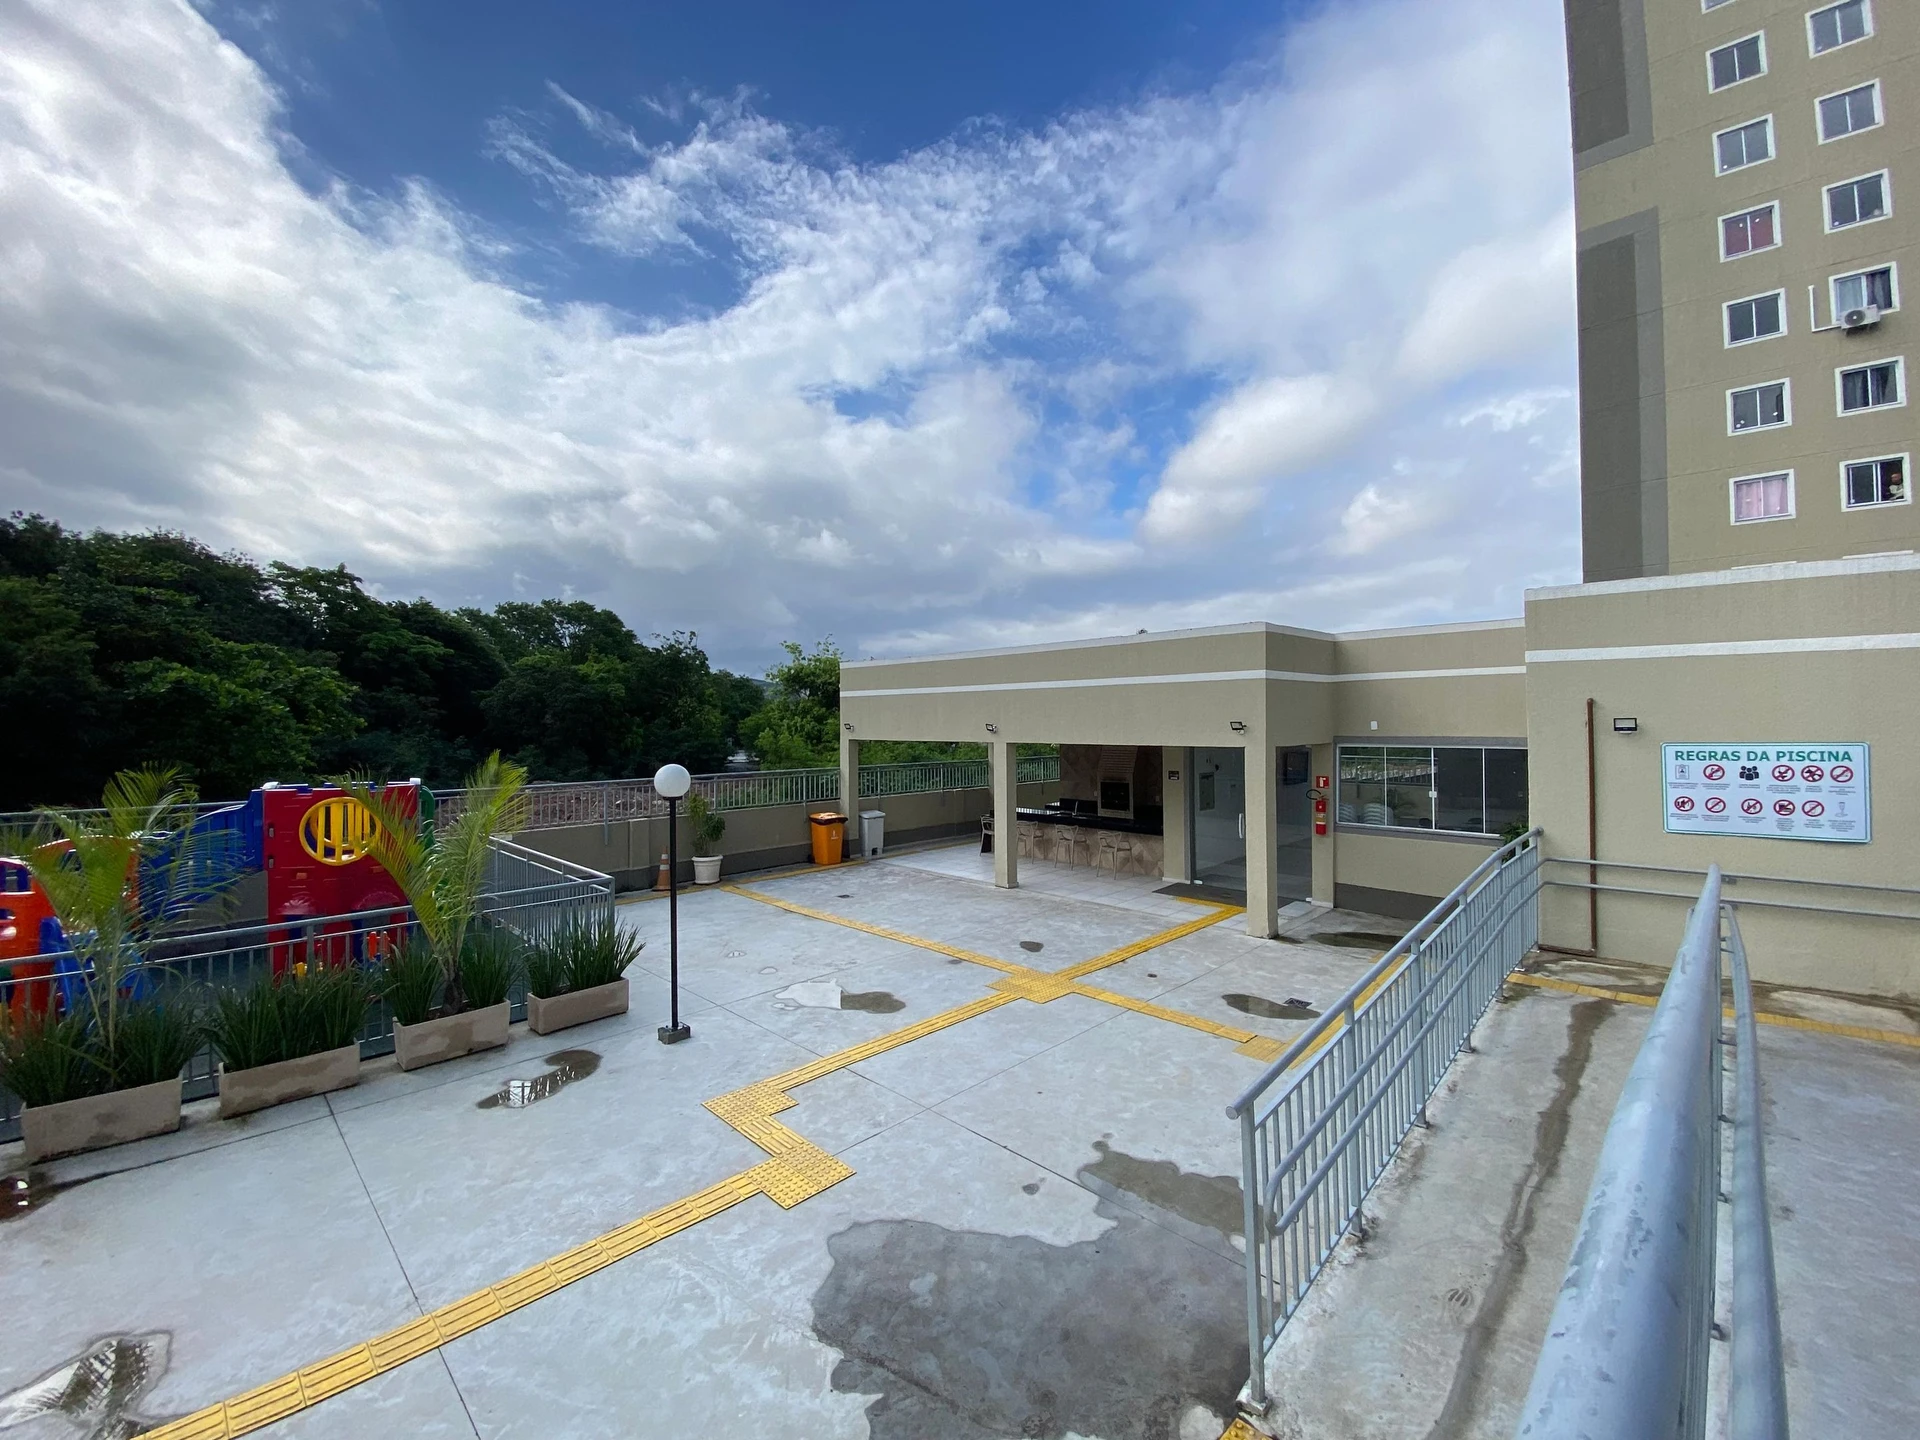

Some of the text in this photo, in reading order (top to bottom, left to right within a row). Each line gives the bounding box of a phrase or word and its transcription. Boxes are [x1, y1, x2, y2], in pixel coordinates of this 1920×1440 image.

[1674, 750, 1853, 762] REGRAS DA PISCINA
